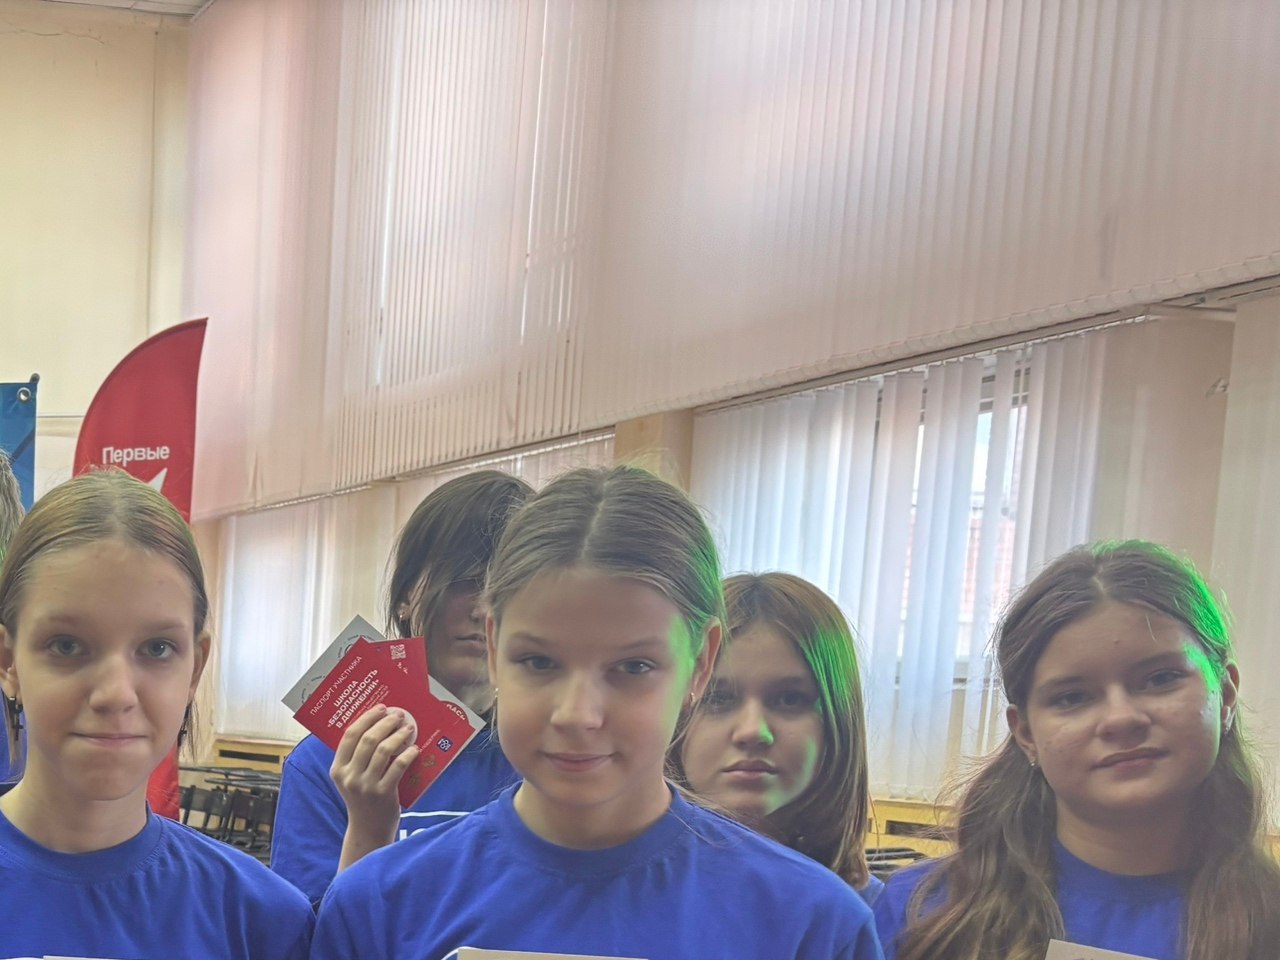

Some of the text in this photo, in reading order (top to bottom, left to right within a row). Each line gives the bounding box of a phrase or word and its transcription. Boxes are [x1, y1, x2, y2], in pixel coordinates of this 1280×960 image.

[102, 446, 170, 467] Первые
[310, 687, 335, 716] ПАСПОРТ
[333, 680, 359, 707] ШКОЛА
